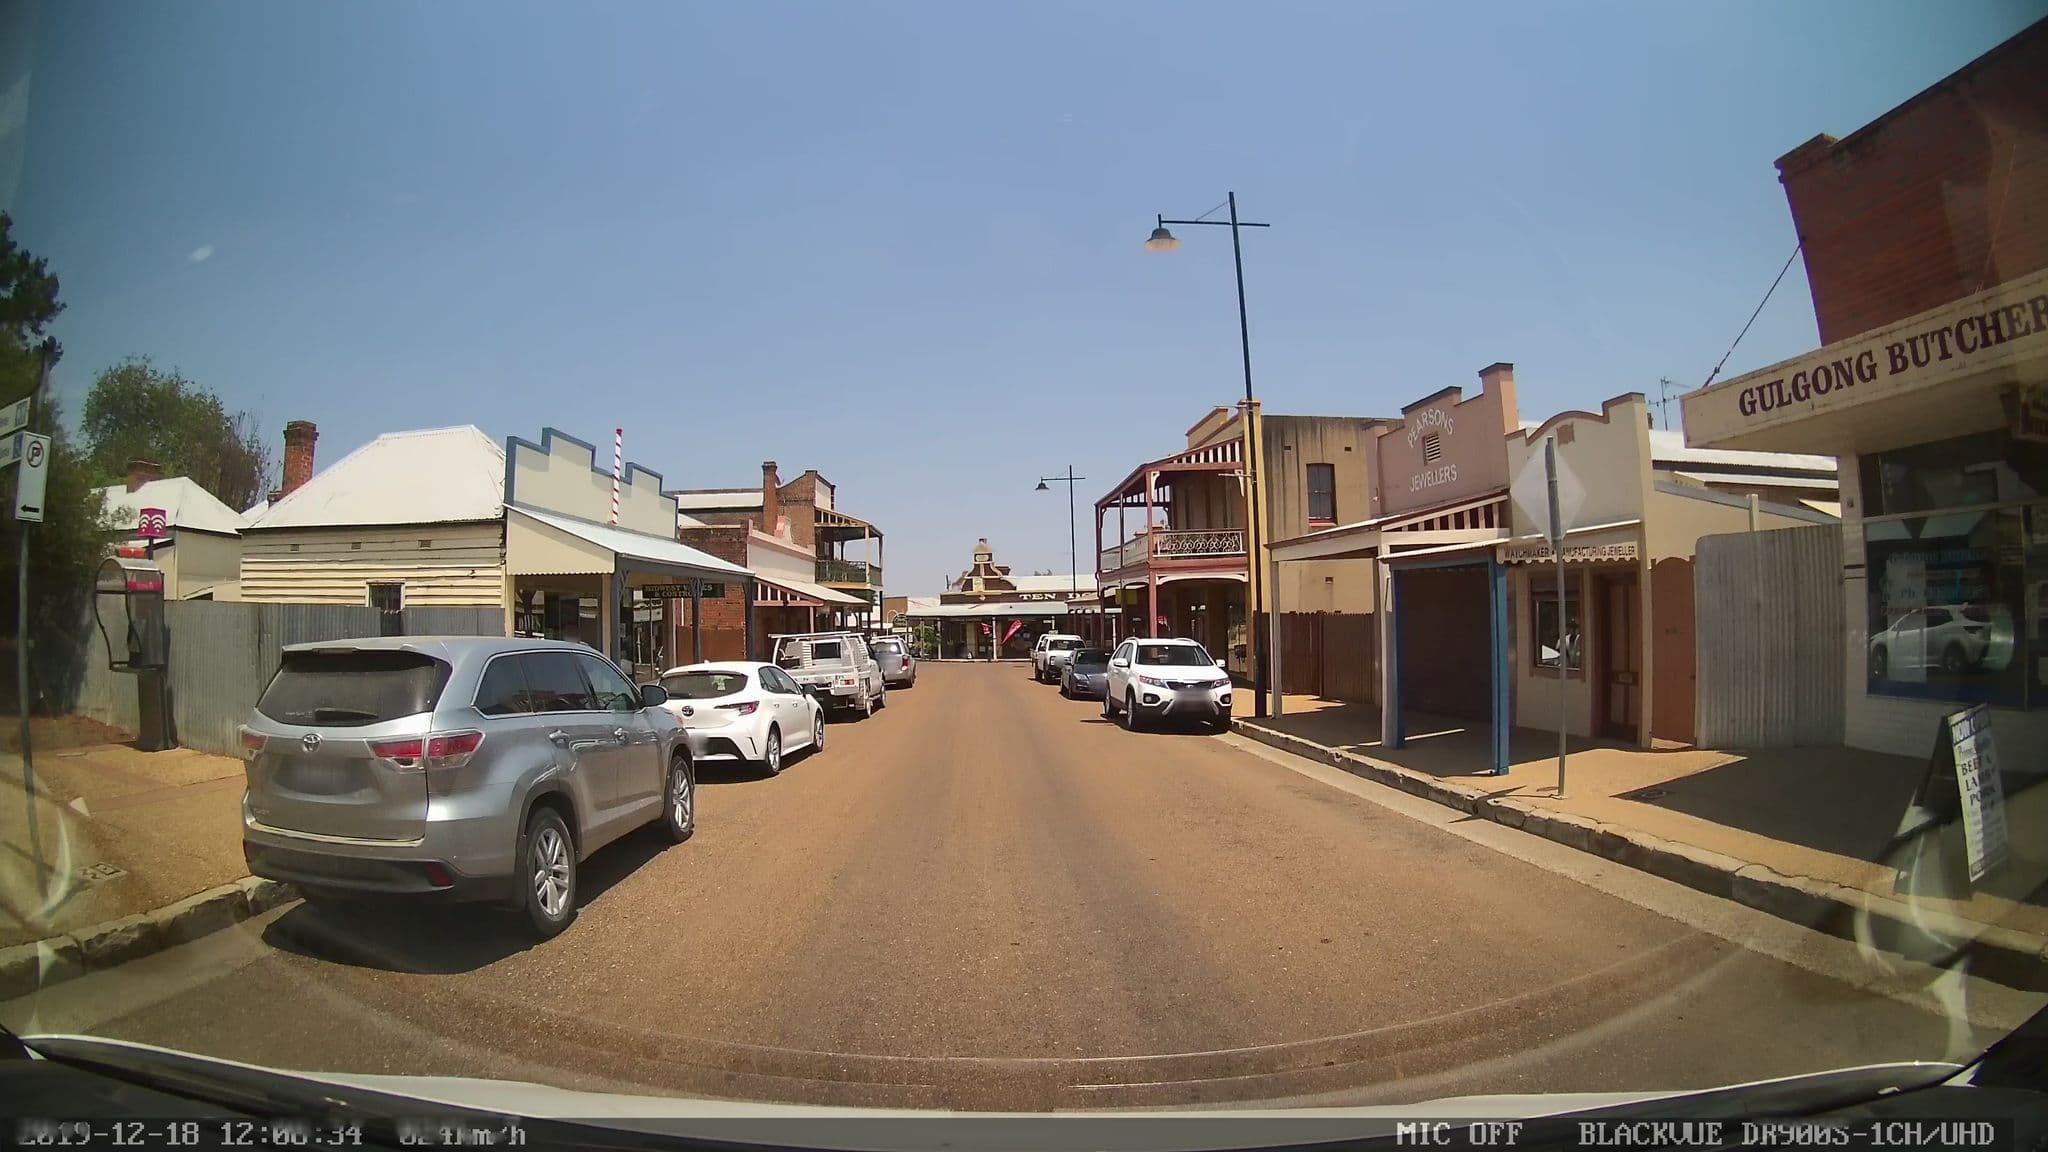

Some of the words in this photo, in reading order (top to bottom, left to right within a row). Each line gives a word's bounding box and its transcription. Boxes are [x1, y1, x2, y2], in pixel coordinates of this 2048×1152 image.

[1739, 350, 1877, 416] GULGONG
[1407, 408, 1454, 448] PEARSONS
[1410, 464, 1457, 492] JEWELLERS
[1504, 546, 1549, 559] WATCHMAKER
[1561, 546, 1606, 557] ANUFACTURING
[1607, 545, 1635, 556] JEWELLER
